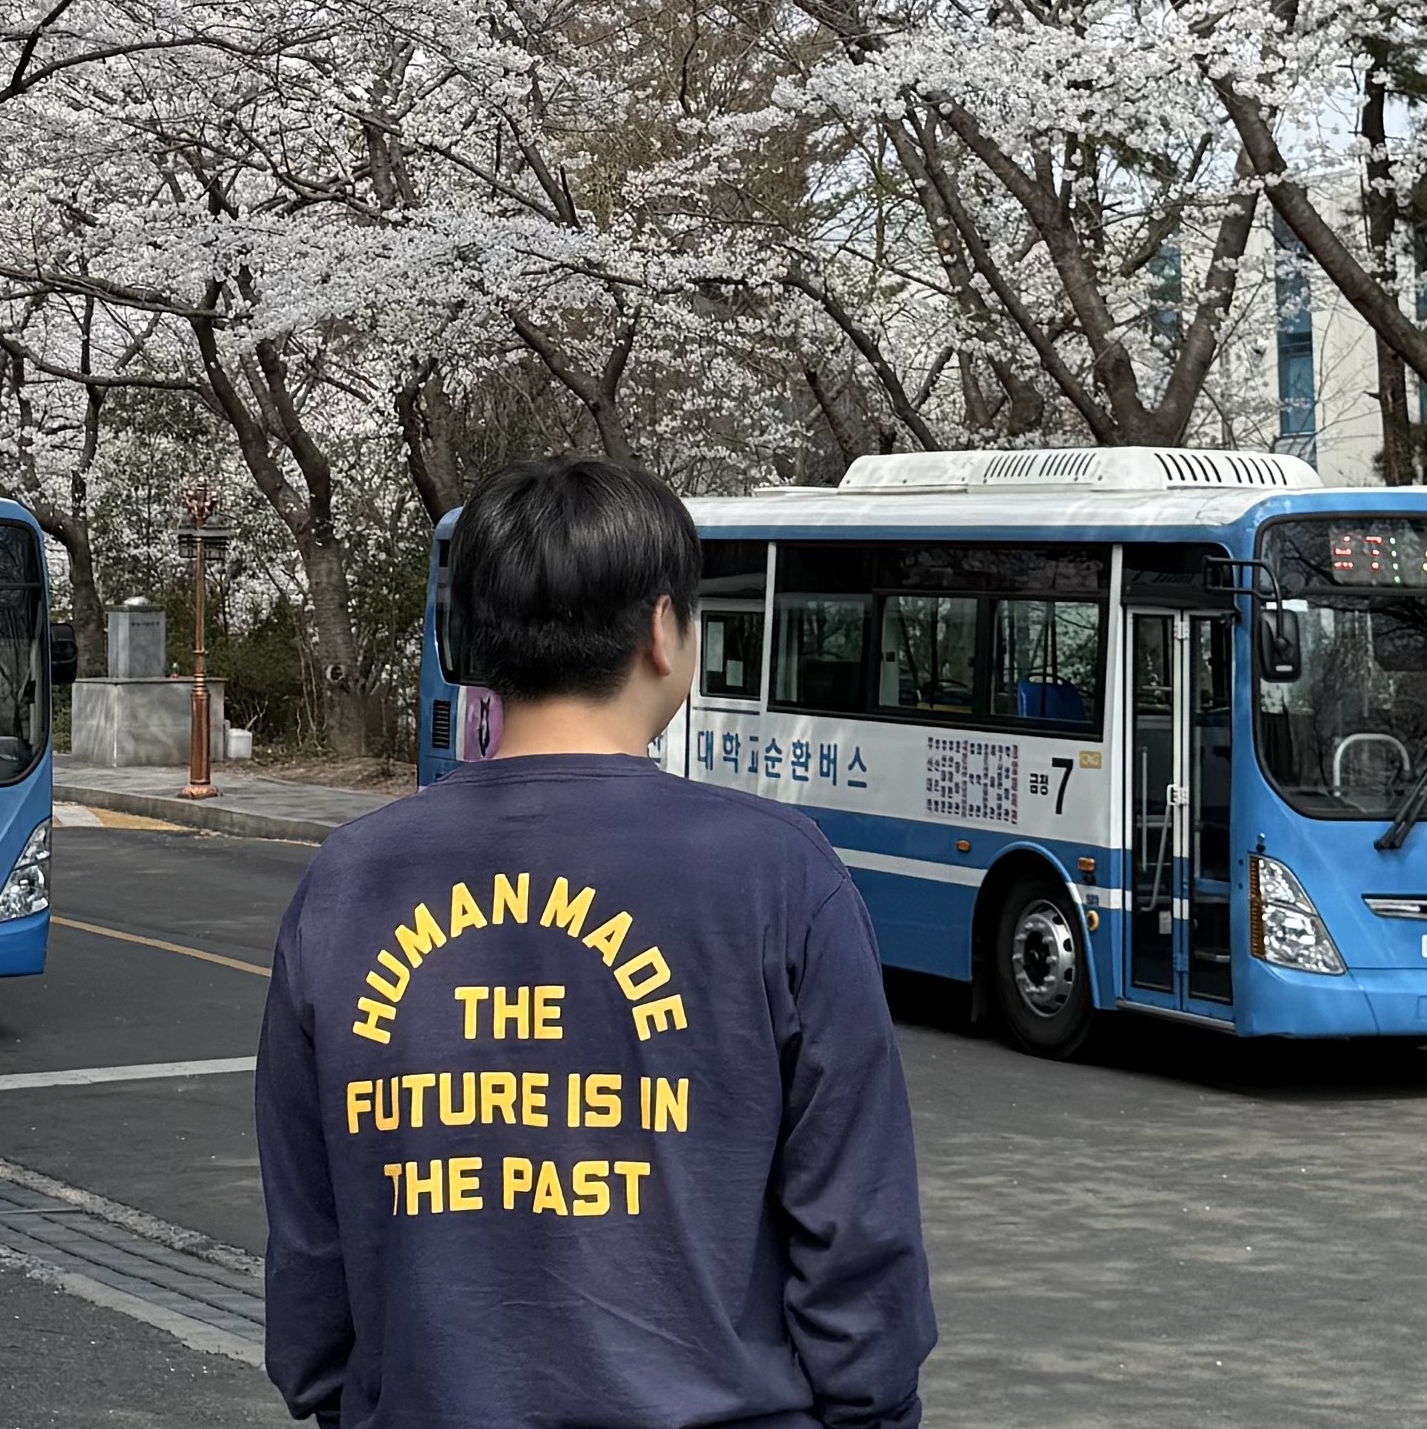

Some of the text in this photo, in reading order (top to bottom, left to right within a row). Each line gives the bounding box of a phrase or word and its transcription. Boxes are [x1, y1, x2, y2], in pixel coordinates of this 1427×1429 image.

[1052, 757, 1074, 815] 7
[454, 986, 565, 1039] THE
[347, 1072, 689, 1134] FUTURE IS IN
[384, 1156, 650, 1216] THE PAST
